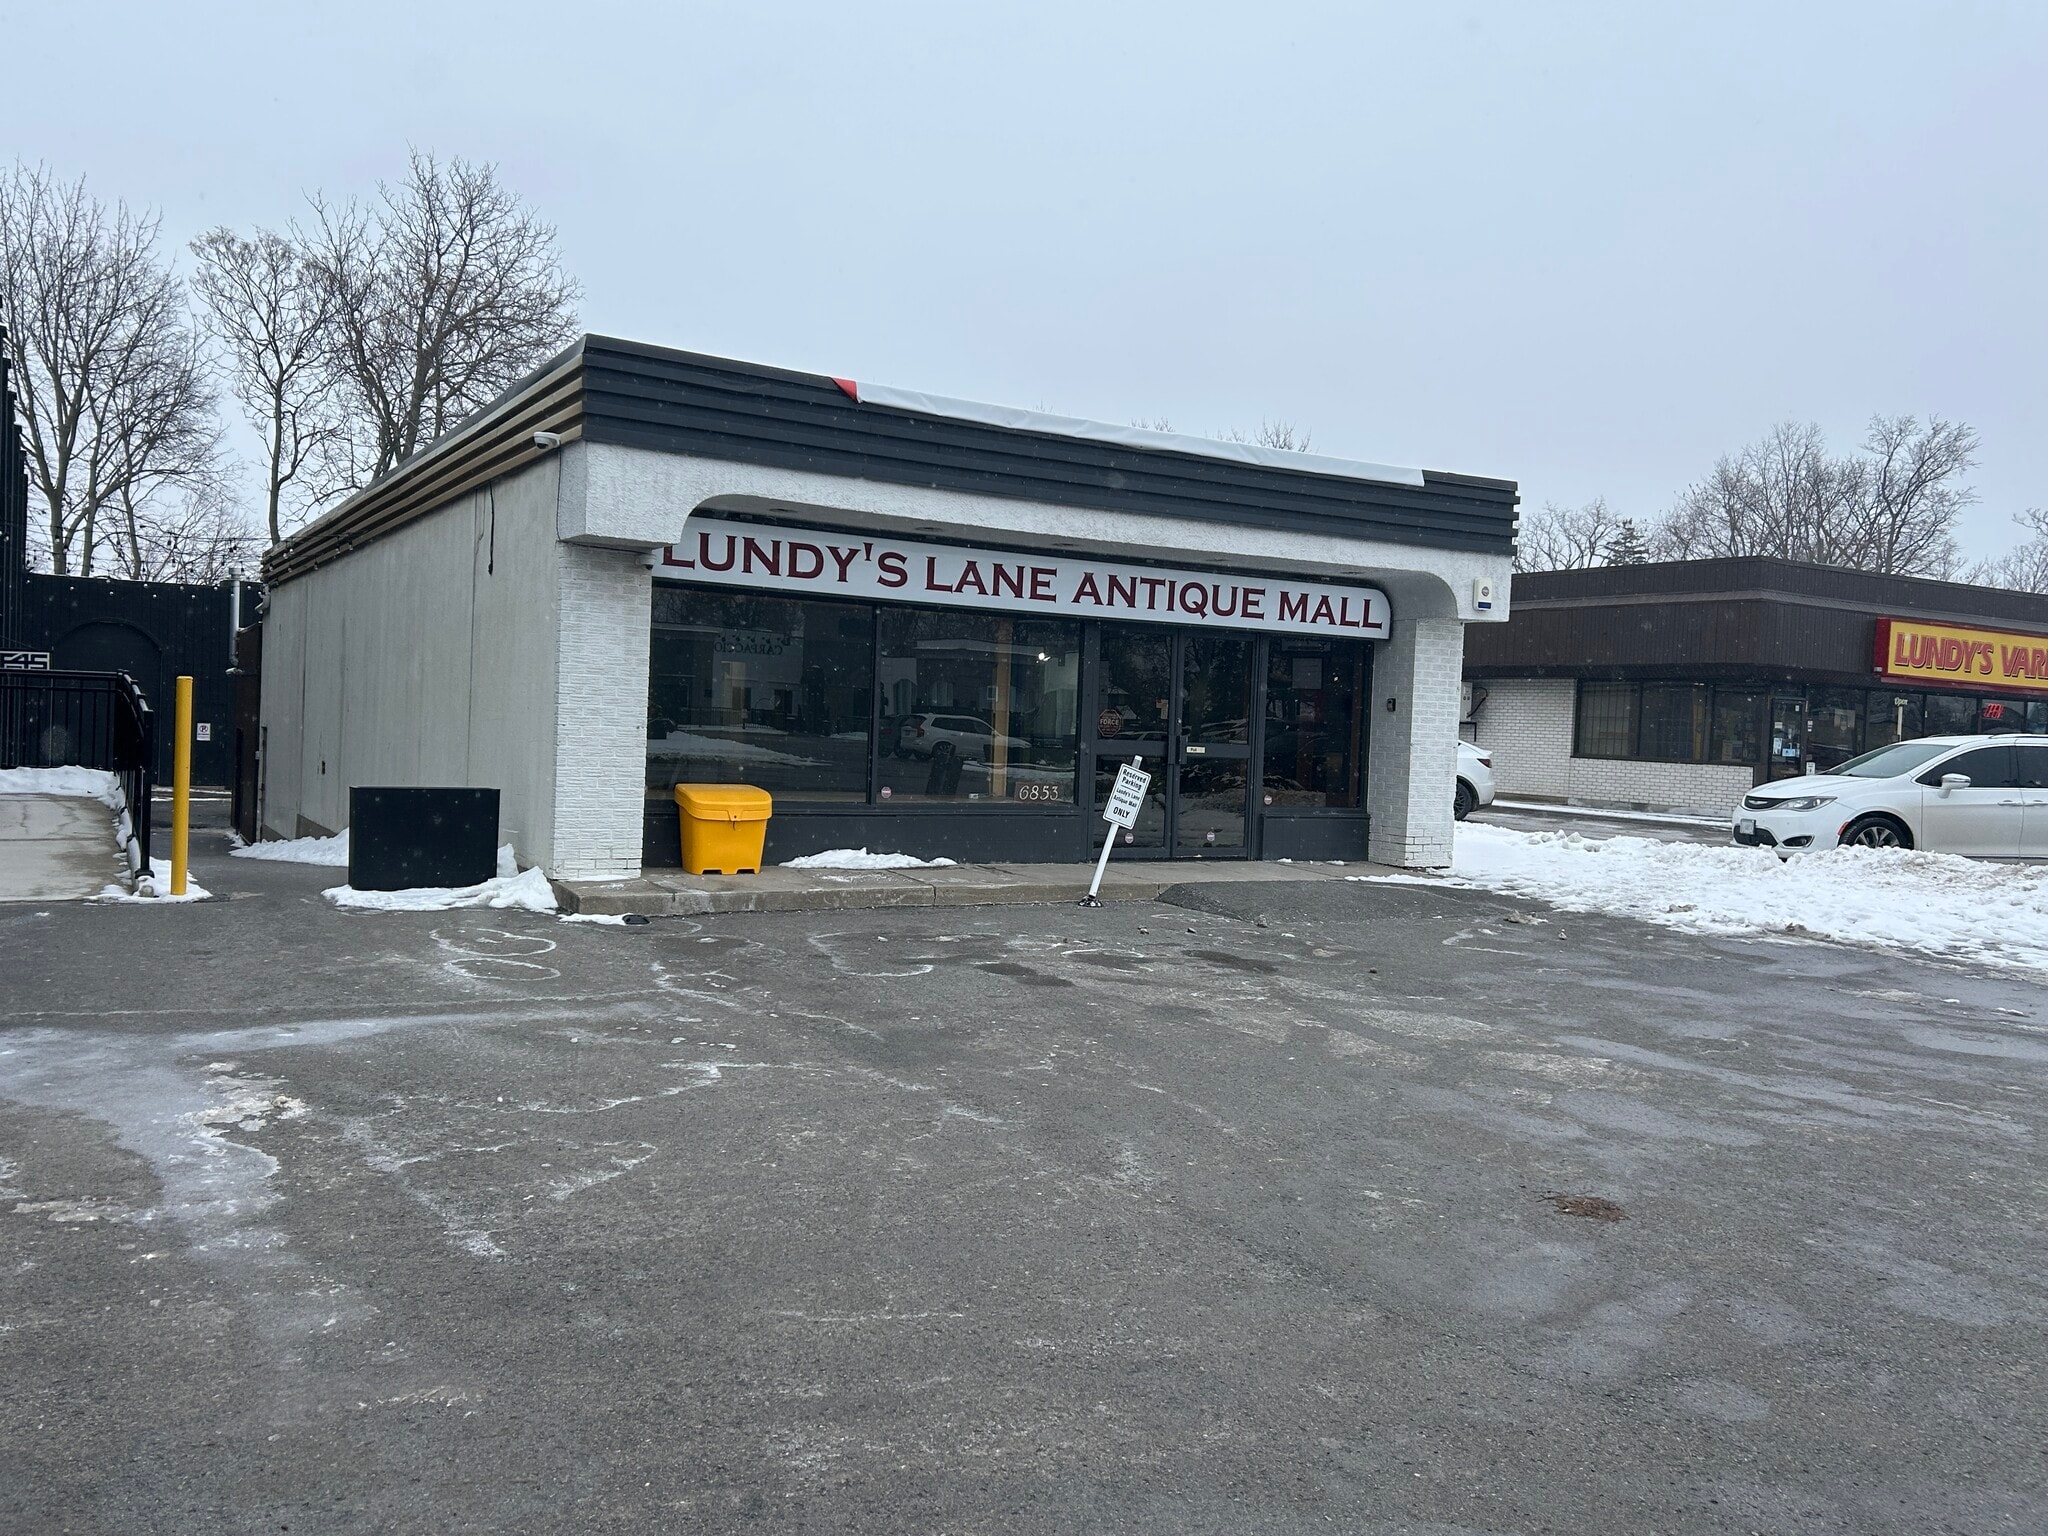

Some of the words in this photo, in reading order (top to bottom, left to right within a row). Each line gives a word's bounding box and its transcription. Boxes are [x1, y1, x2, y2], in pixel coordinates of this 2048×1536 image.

[661, 531, 909, 588] LUNDY'S
[925, 556, 1057, 603] LANE
[1070, 571, 1266, 620] ANTIQUE
[1277, 590, 1383, 630] MALL
[1894, 631, 1995, 675] LUNDY'S
[1121, 776, 1142, 791] Parking
[1123, 768, 1147, 784] Reserved
[1019, 785, 1059, 801] 6853
[1113, 806, 1130, 818] ONLY
